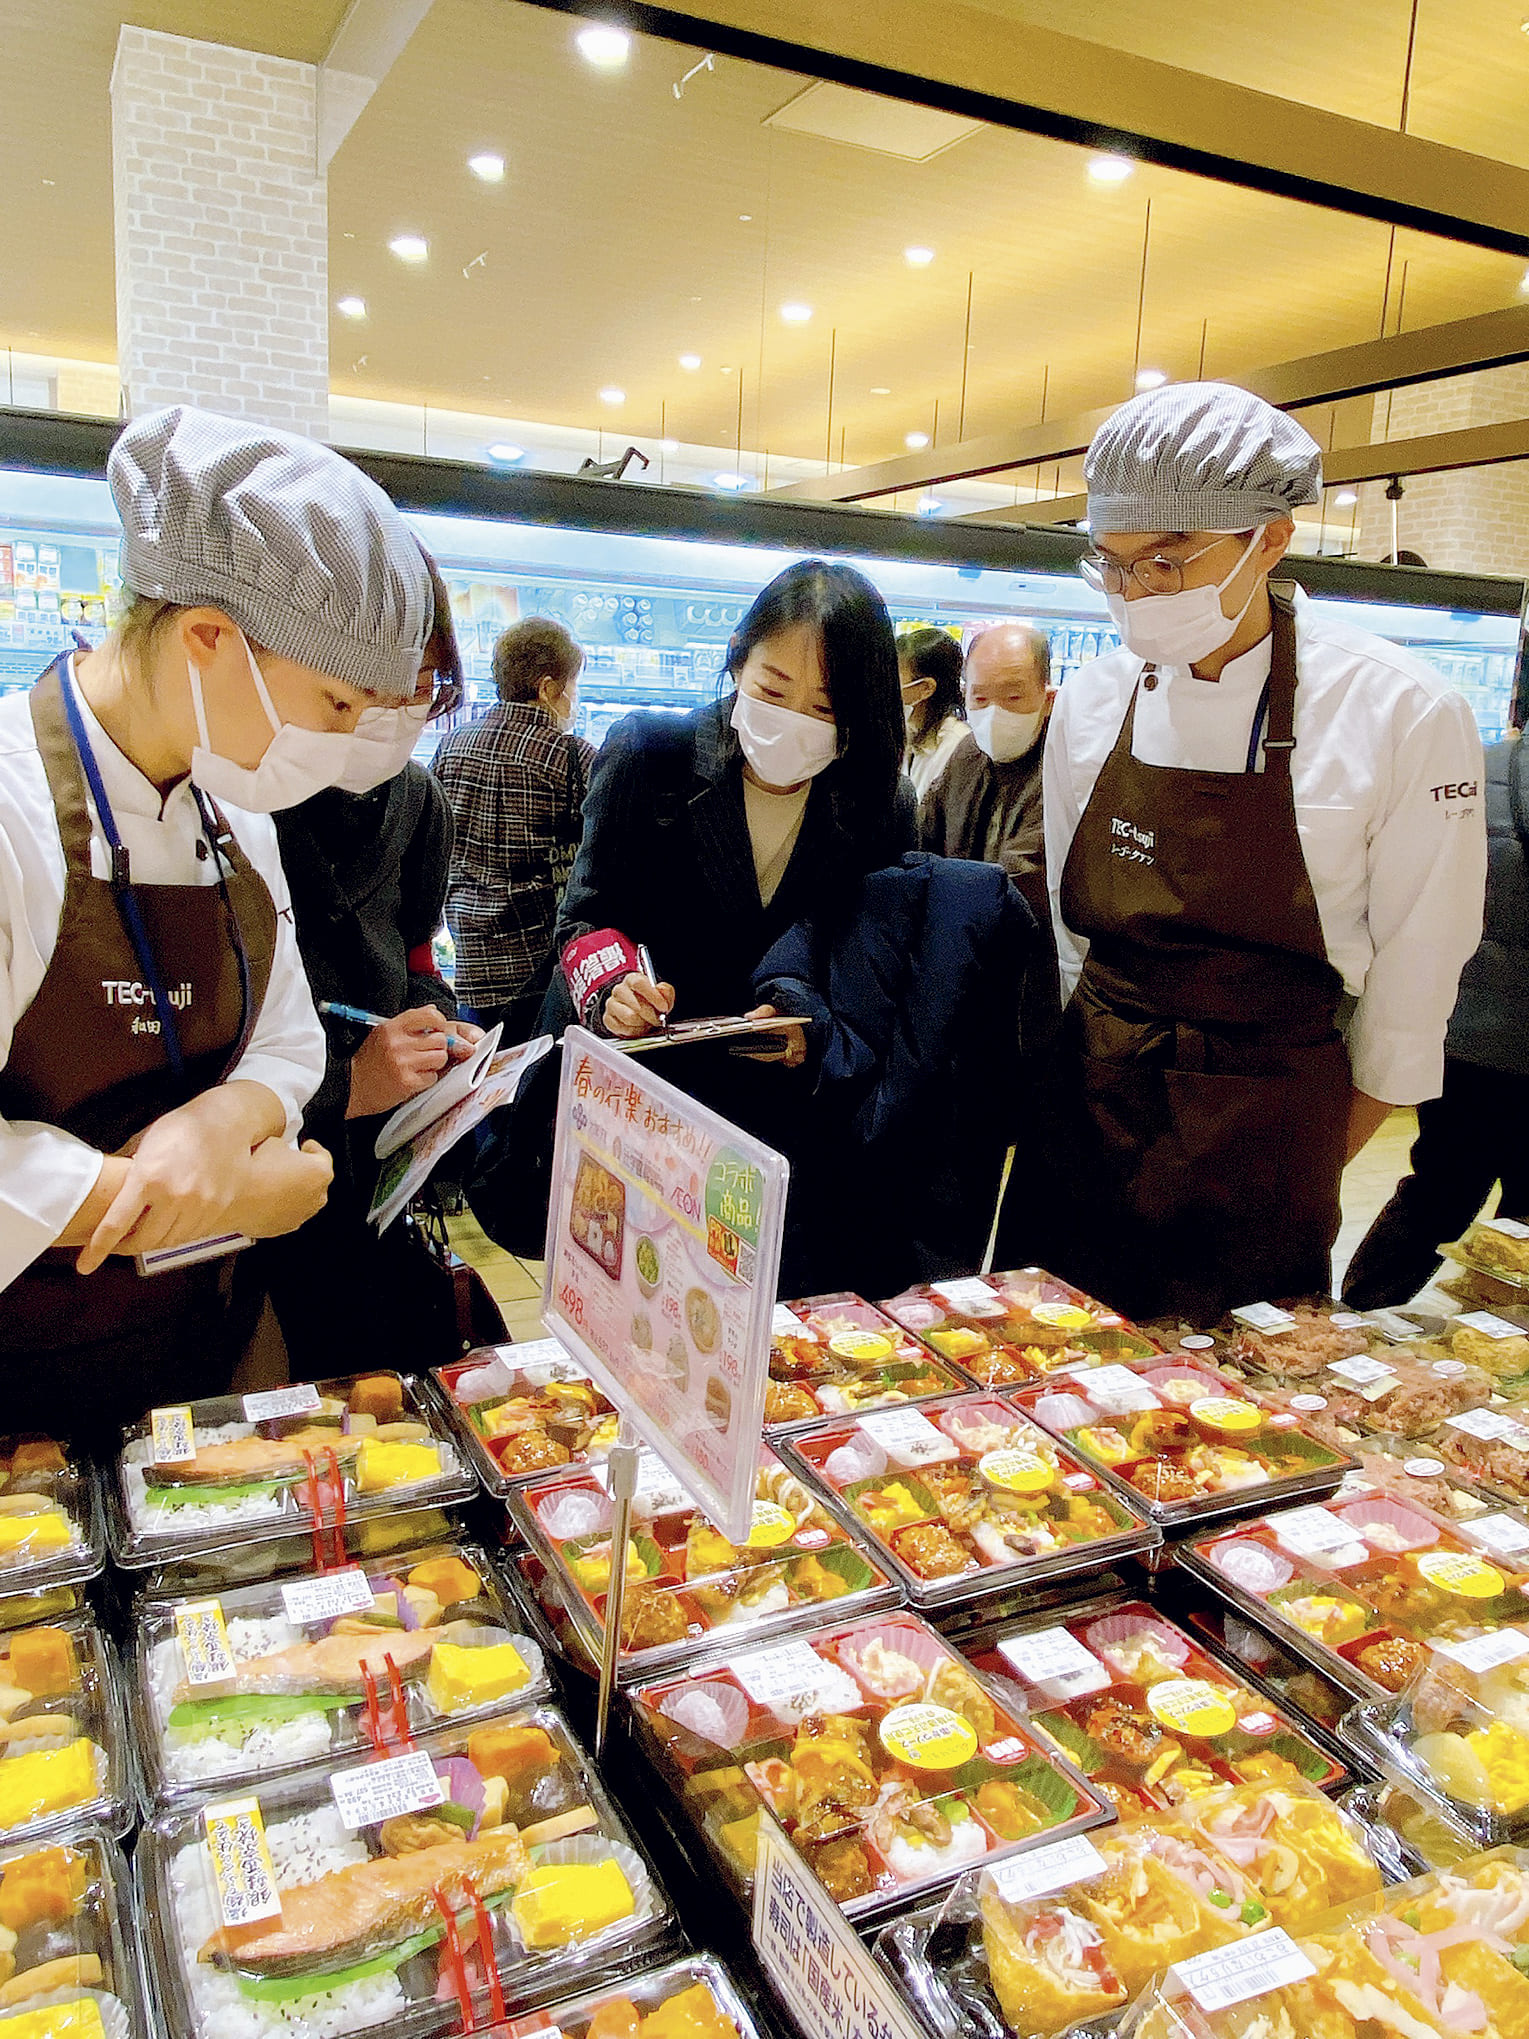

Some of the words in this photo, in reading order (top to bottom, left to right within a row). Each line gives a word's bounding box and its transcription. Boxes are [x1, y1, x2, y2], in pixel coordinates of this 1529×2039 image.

[101, 981, 193, 1010] TEC-tuji
[131, 1015, 161, 1035] 和田
[713, 1162, 756, 1193] コラボ
[235, 1817, 273, 1907] 銀鮭西京焼き
